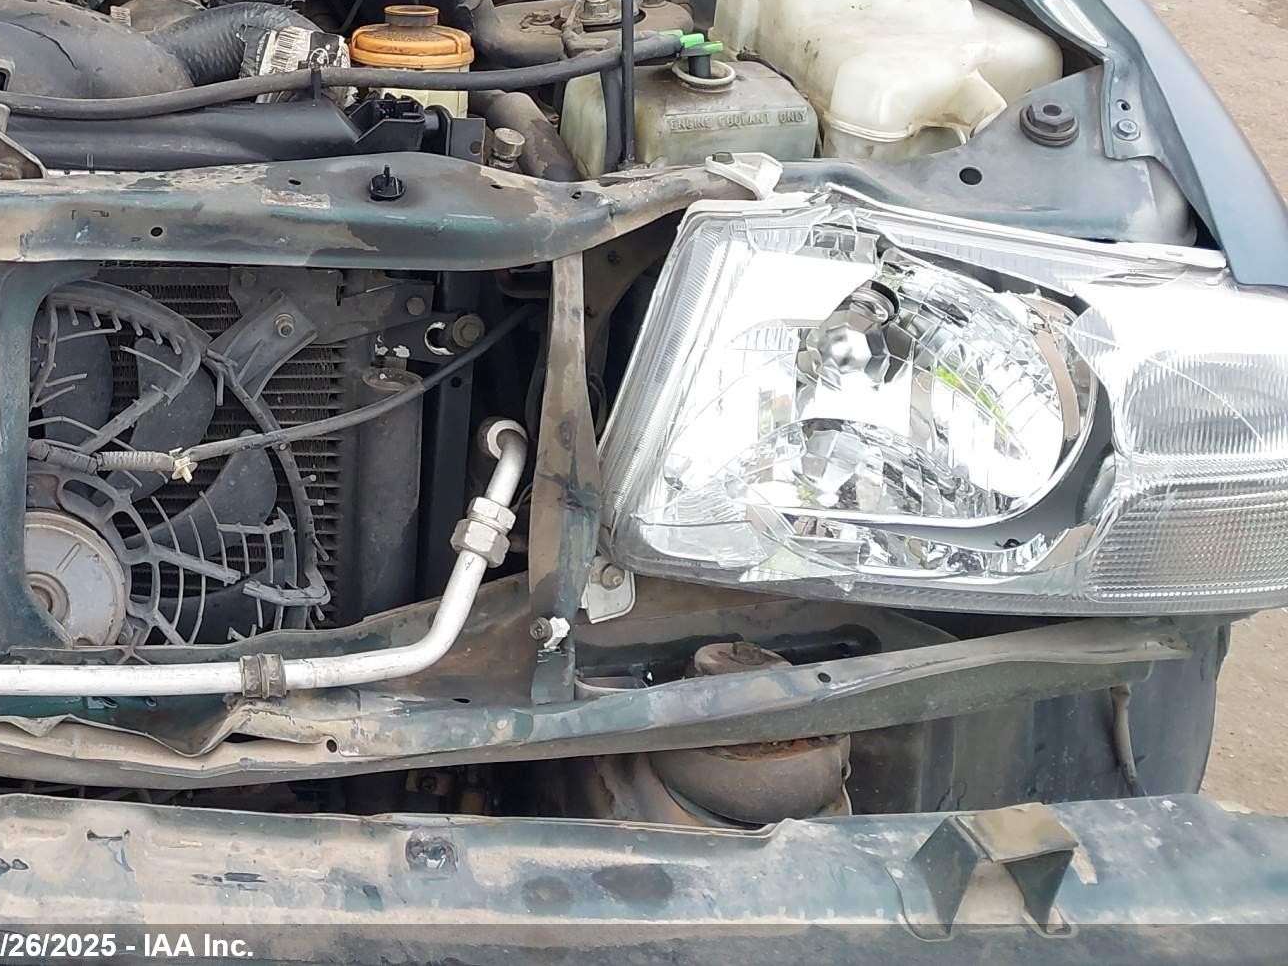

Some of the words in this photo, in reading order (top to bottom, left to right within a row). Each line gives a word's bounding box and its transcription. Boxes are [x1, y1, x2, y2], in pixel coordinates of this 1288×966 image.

[669, 116, 713, 131] ENGINE
[717, 112, 770, 129] COOLANT
[778, 109, 807, 124] ONLY
